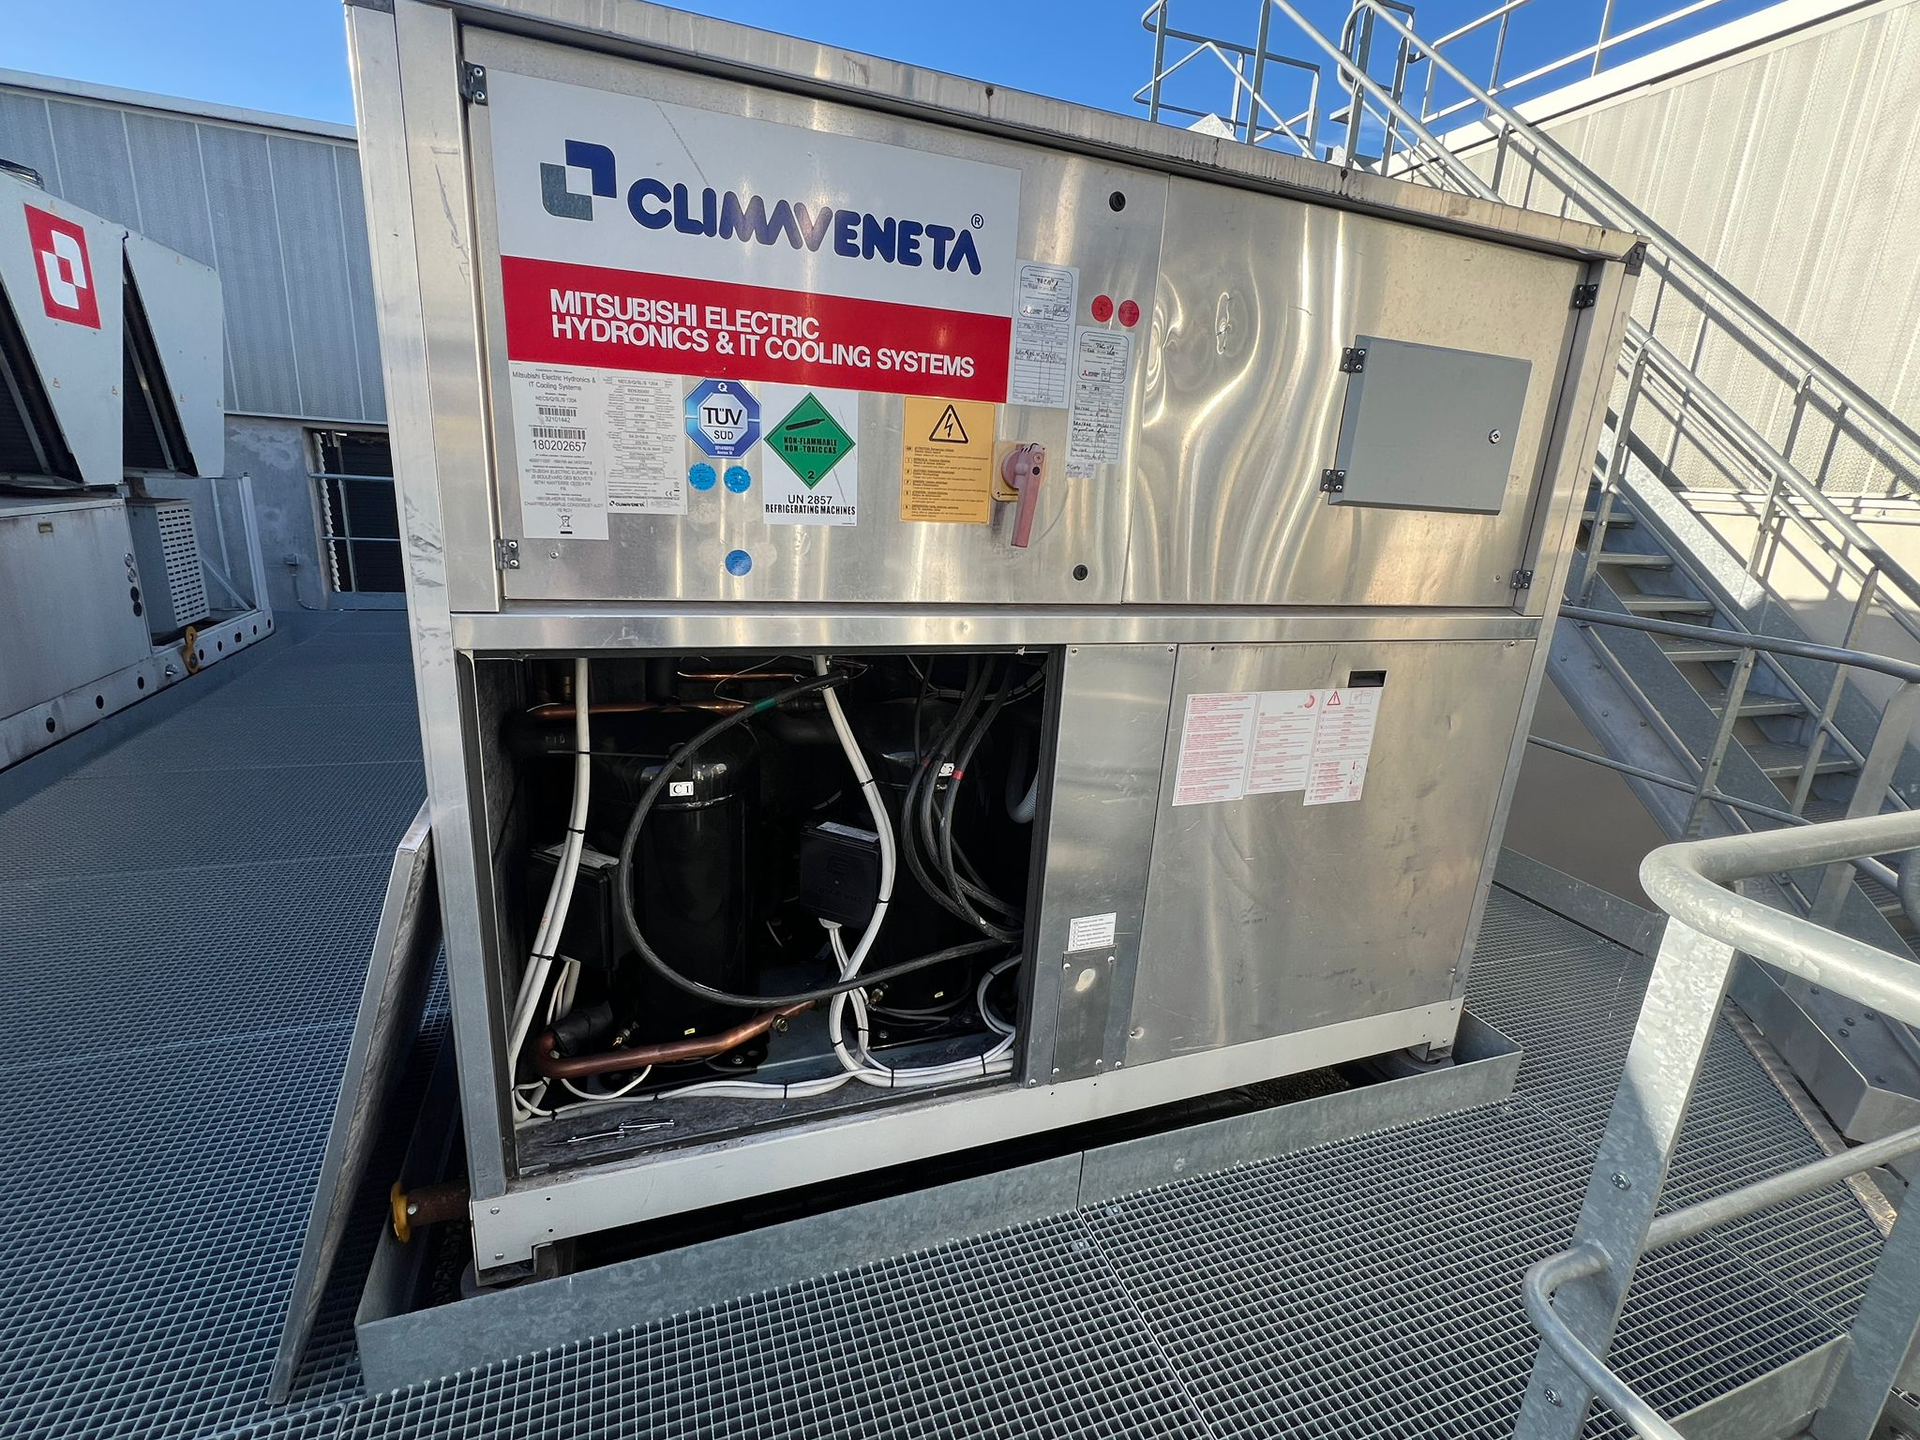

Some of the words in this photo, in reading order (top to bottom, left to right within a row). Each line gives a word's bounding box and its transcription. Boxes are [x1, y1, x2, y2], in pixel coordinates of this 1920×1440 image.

[550, 288, 698, 328] MITSUBISHI
[705, 305, 820, 340] ELECTRIC
[551, 313, 709, 354] HYDRONICS
[715, 334, 734, 356] &
[740, 335, 759, 357] IT
[764, 338, 871, 370] COOLING
[876, 346, 975, 379] SYSTEMS
[512, 371, 540, 380] Mitsubishi
[541, 373, 562, 381] Electric
[563, 375, 591, 383] Hydronics
[536, 382, 557, 390] Cooling
[558, 383, 582, 391] Systems
[717, 382, 728, 392] Q
[702, 407, 742, 426] TÜV
[714, 430, 734, 440] SÜD
[532, 439, 586, 452] 180202657
[784, 436, 837, 446] NON-FLAMMABLE
[808, 470, 815, 480] 2
[788, 494, 804, 504] UN
[807, 496, 833, 505] 2857
[765, 504, 820, 514] REFRIGERATING
[820, 506, 856, 516] MACHINES
